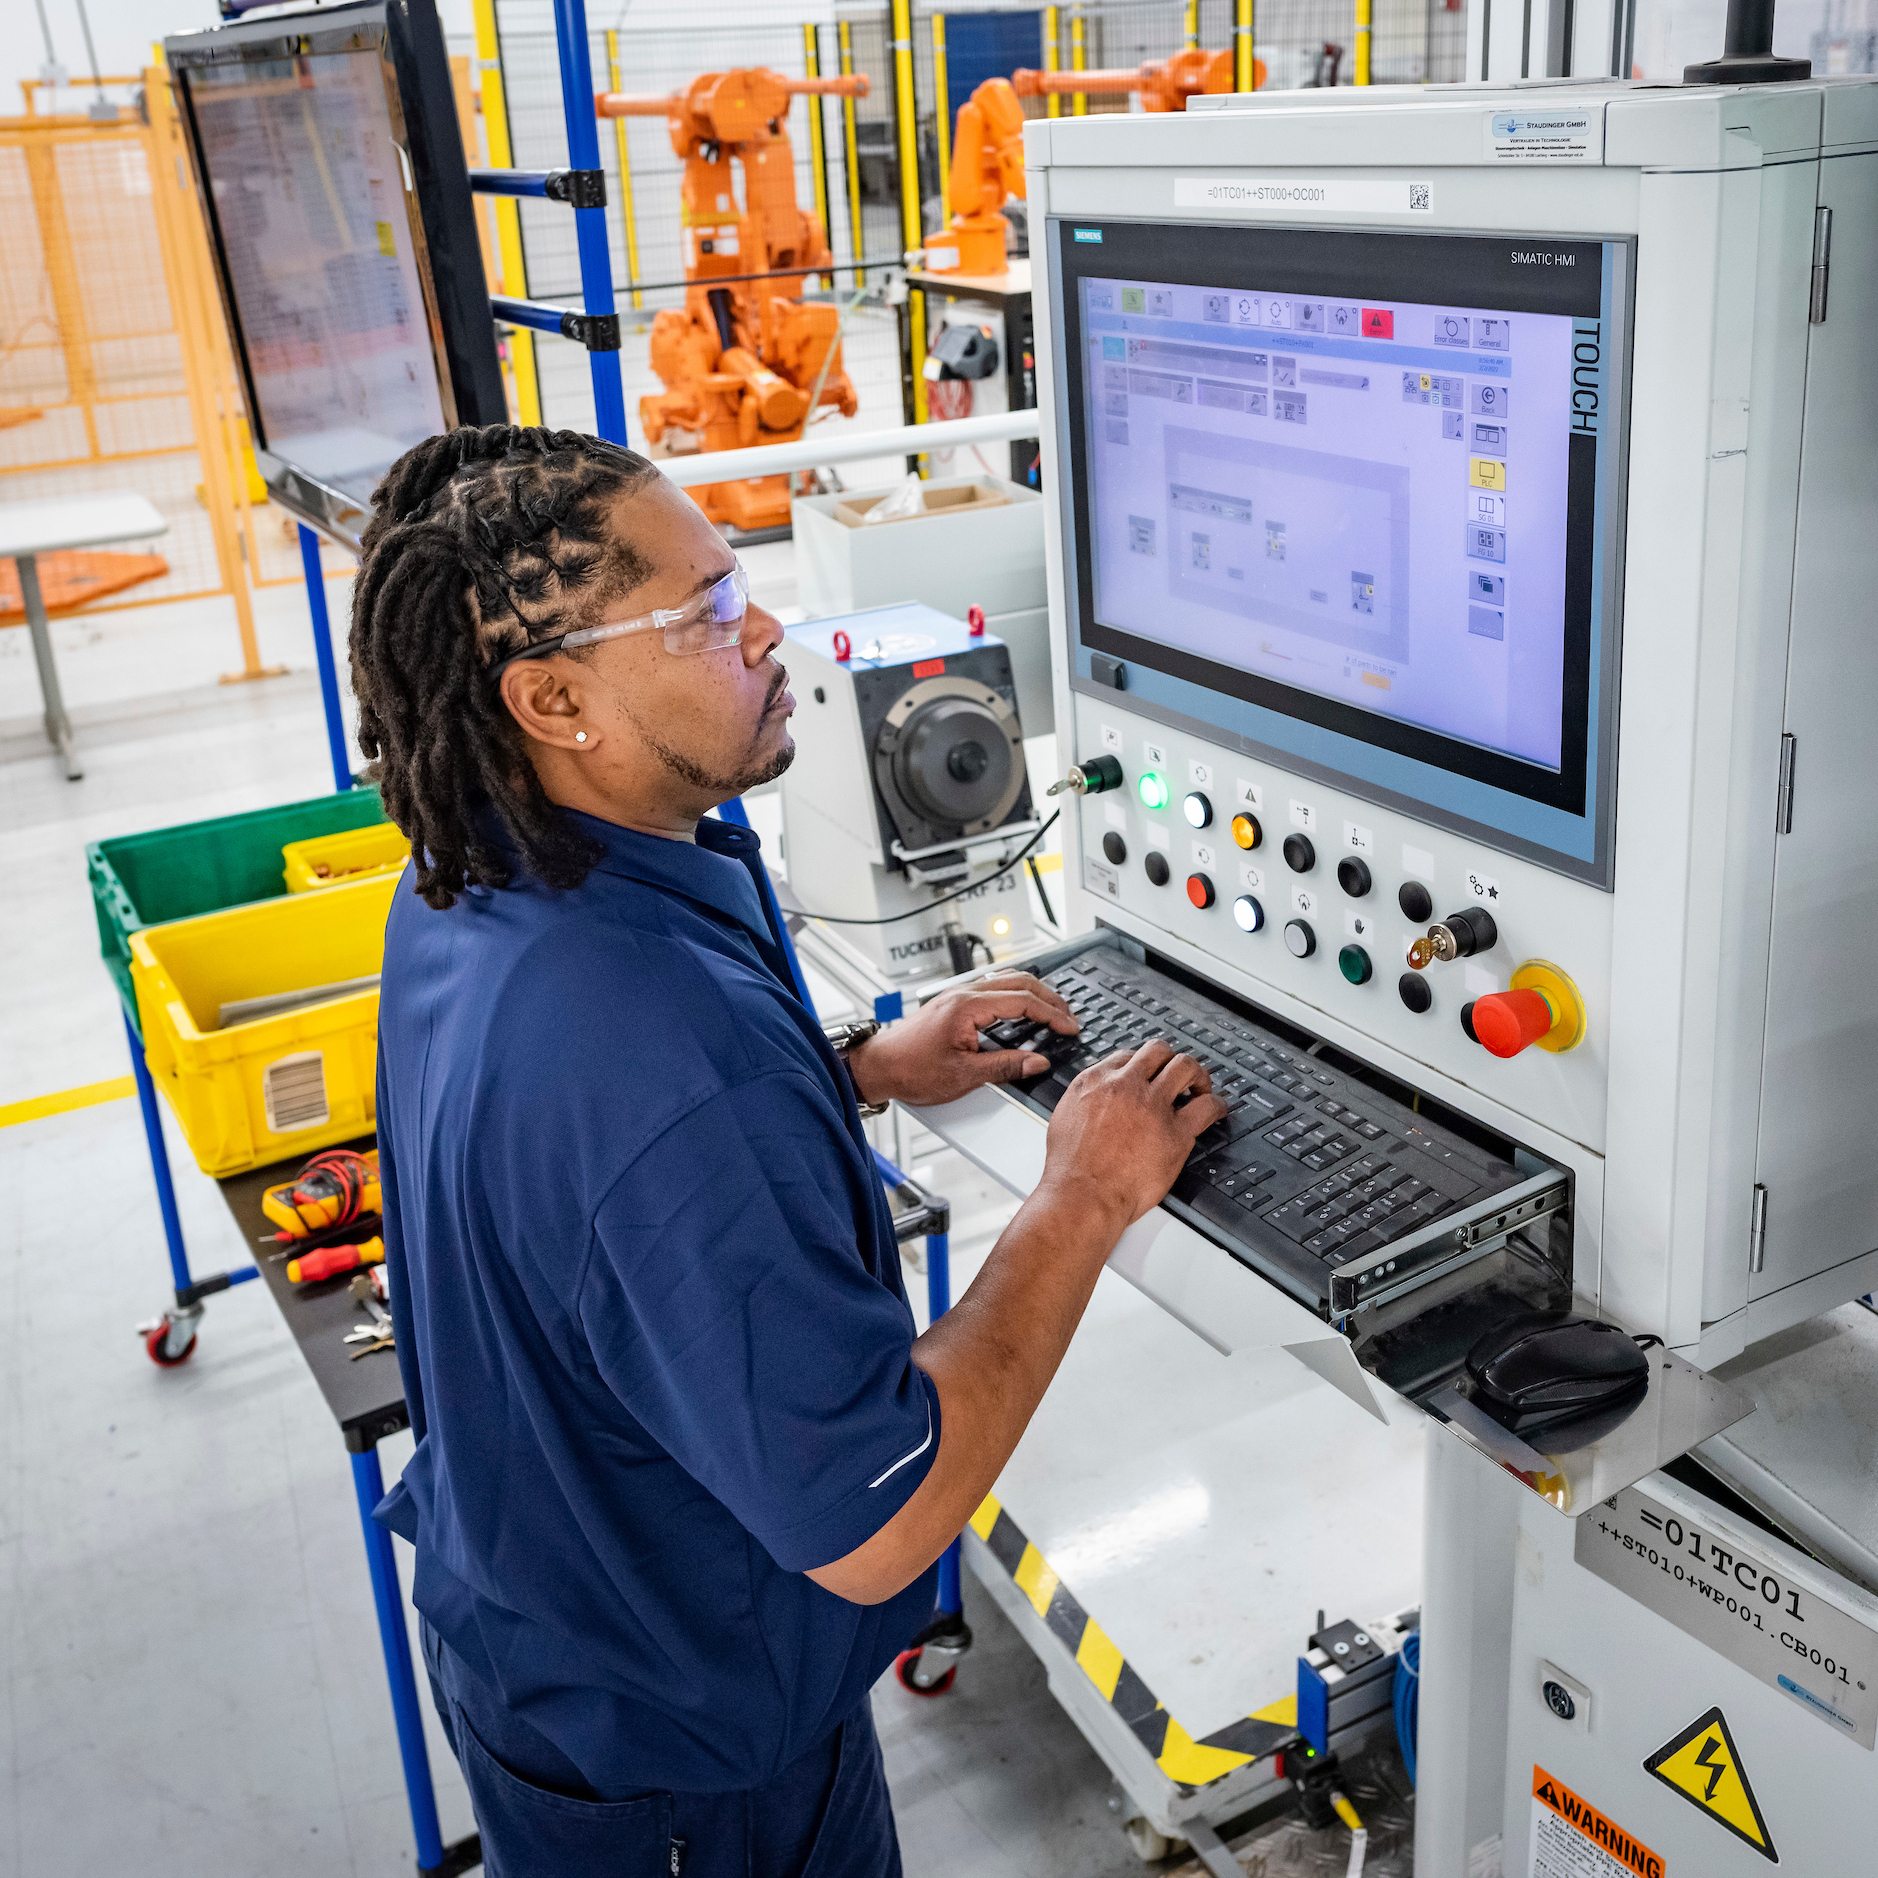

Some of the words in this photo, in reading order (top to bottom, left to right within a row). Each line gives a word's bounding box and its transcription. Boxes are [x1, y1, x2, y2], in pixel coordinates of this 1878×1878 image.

[1208, 186, 1325, 201] =01TC01++ST000+OC001
[1076, 231, 1101, 240] SIEMENS
[1511, 251, 1552, 266] SIMATIC
[1554, 254, 1576, 267] HMI
[1434, 334, 1447, 343] Error
[1448, 338, 1469, 346] classes
[1478, 338, 1501, 348] General
[1571, 322, 1600, 433] TOUCH
[1481, 406, 1495, 414] Back
[1481, 479, 1493, 488] PLC
[1478, 513, 1487, 522] SG
[1487, 515, 1495, 523] 01
[1487, 549, 1495, 558] 10
[890, 935, 945, 961] TUCKER
[1640, 1508, 1805, 1622] =01TC01
[1598, 1521, 1851, 1685] ++ST010+WP001.CB001
[1562, 1791, 1660, 1878] WARNING
